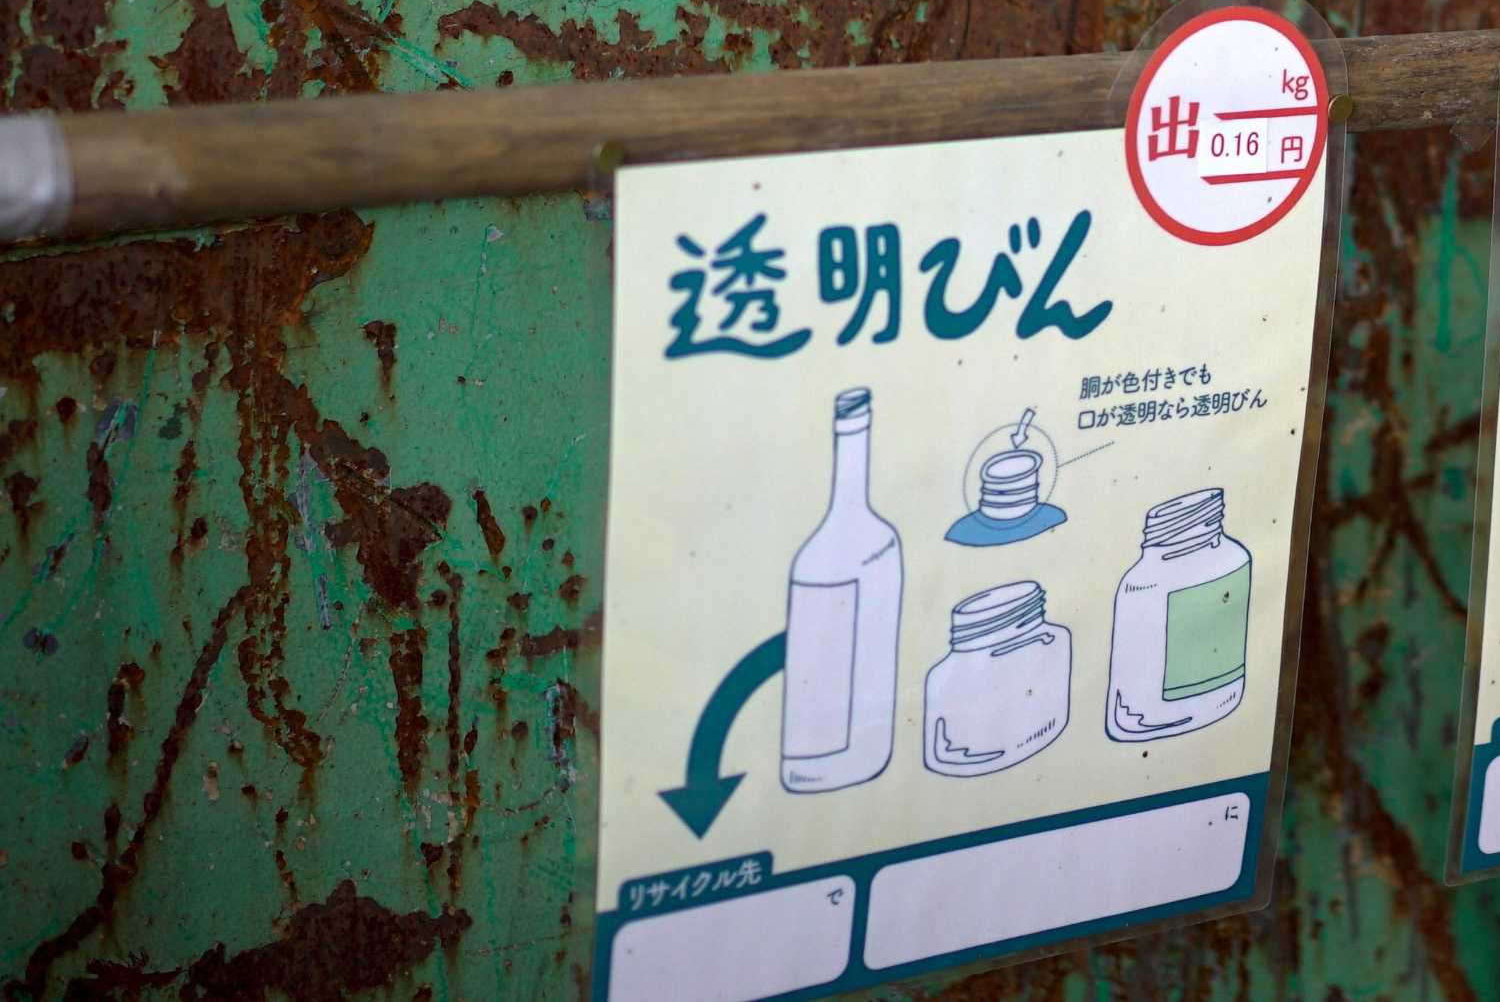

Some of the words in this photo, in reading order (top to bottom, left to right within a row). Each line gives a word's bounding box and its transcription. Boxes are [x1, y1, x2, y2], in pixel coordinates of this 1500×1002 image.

[1282, 69, 1309, 100] kg
[1148, 95, 1200, 161] 出
[1211, 132, 1259, 157] 0.16
[1280, 136, 1303, 163] 円
[664, 209, 1113, 359] 透明びん
[1079, 363, 1212, 400] 胴が色付きでも
[1077, 389, 1268, 429] 口が透明なら透明びん
[1225, 805, 1239, 821] に
[629, 859, 762, 911] リサイクル先
[827, 887, 844, 906] で
